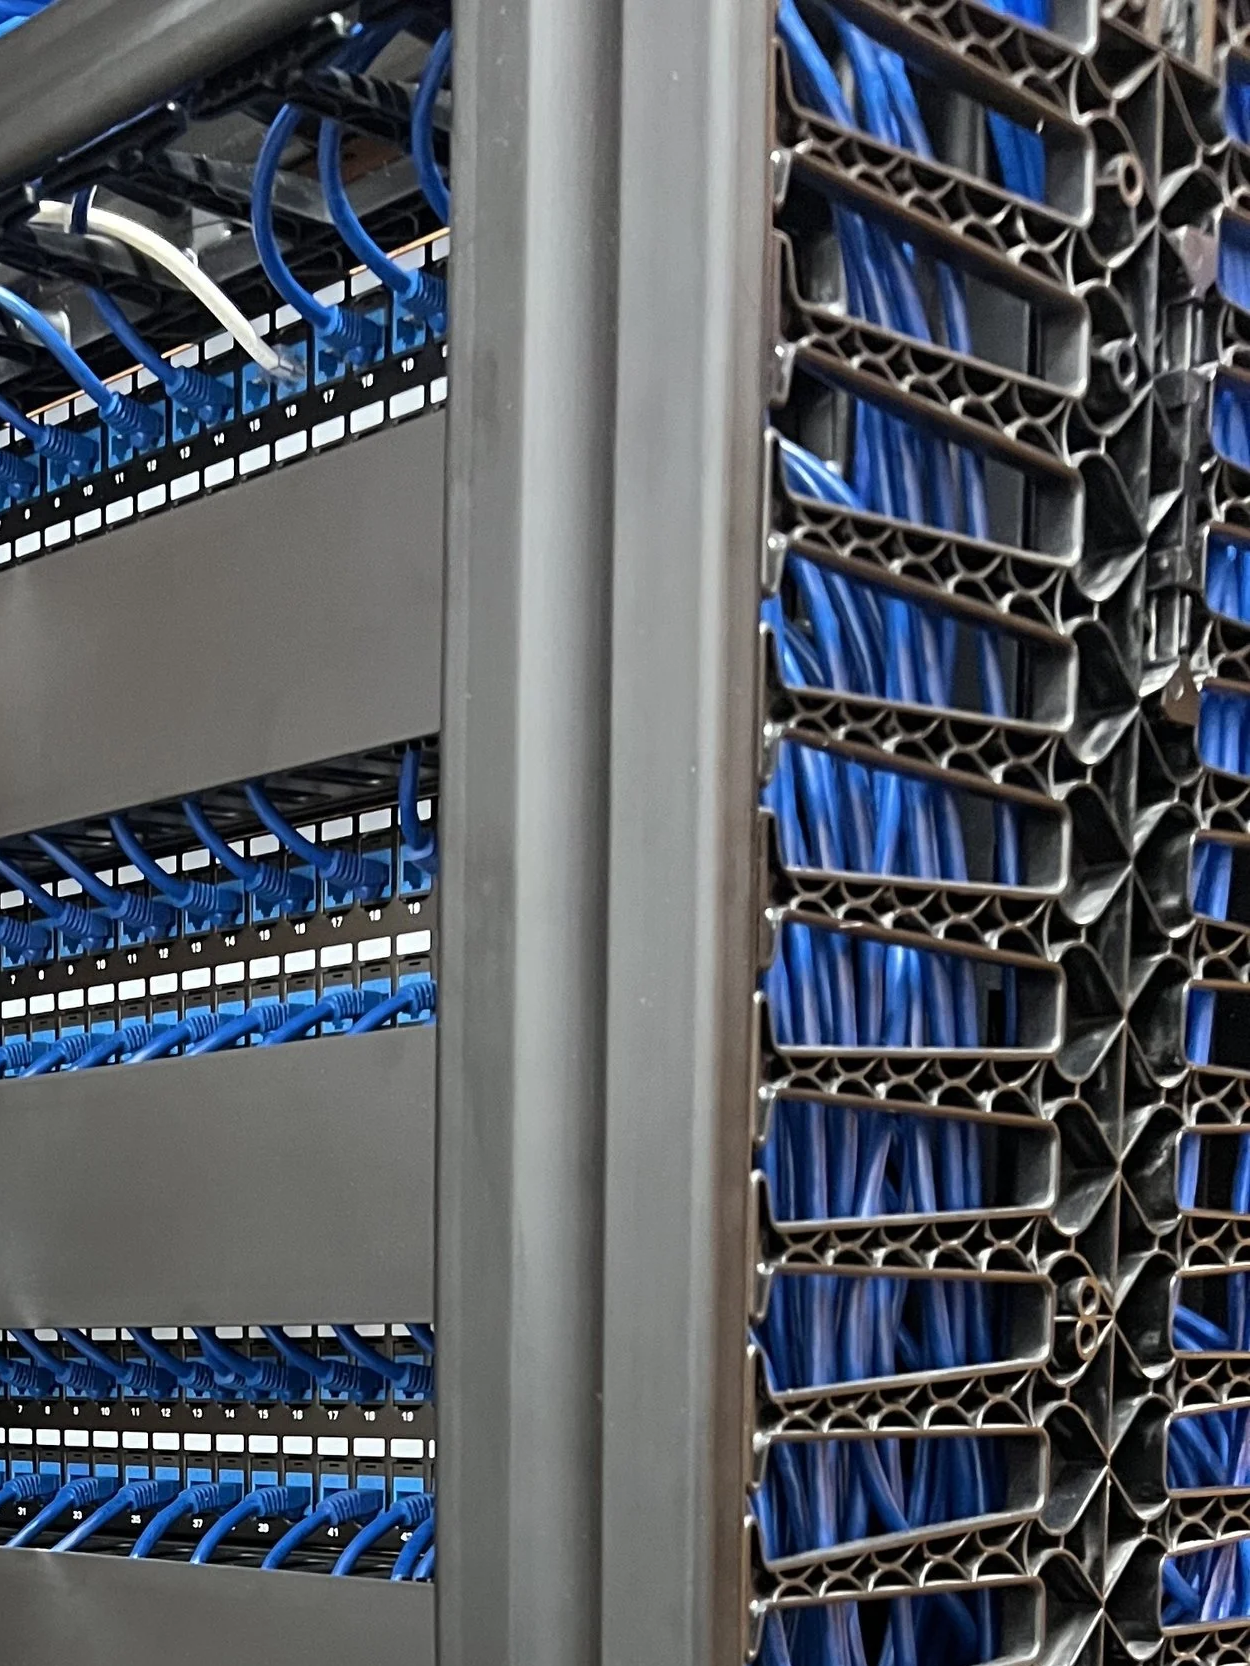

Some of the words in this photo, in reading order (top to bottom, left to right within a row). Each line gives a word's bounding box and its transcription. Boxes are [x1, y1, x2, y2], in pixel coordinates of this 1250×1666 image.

[114, 471, 125, 485] 11
[213, 432, 225, 447] 14
[322, 388, 335, 404] 17
[127, 953, 137, 965] 11
[190, 941, 202, 954] 13
[224, 935, 236, 947] 14
[330, 915, 344, 929] 17
[17, 1404, 23, 1414] 7
[100, 1406, 111, 1417] 10
[130, 1407, 140, 1417] 11
[160, 1407, 171, 1418] 12
[192, 1408, 203, 1419] 13
[224, 1408, 235, 1419] 14
[257, 1408, 269, 1420] 15
[291, 1409, 304, 1421] 16
[327, 1410, 339, 1421] 17
[363, 1410, 376, 1422] 18
[401, 1410, 414, 1423] 19
[17, 1506, 27, 1516] 31
[72, 1510, 83, 1520] 33
[130, 1514, 142, 1524] 35
[192, 1518, 204, 1529] 37
[327, 1526, 339, 1537] 41
